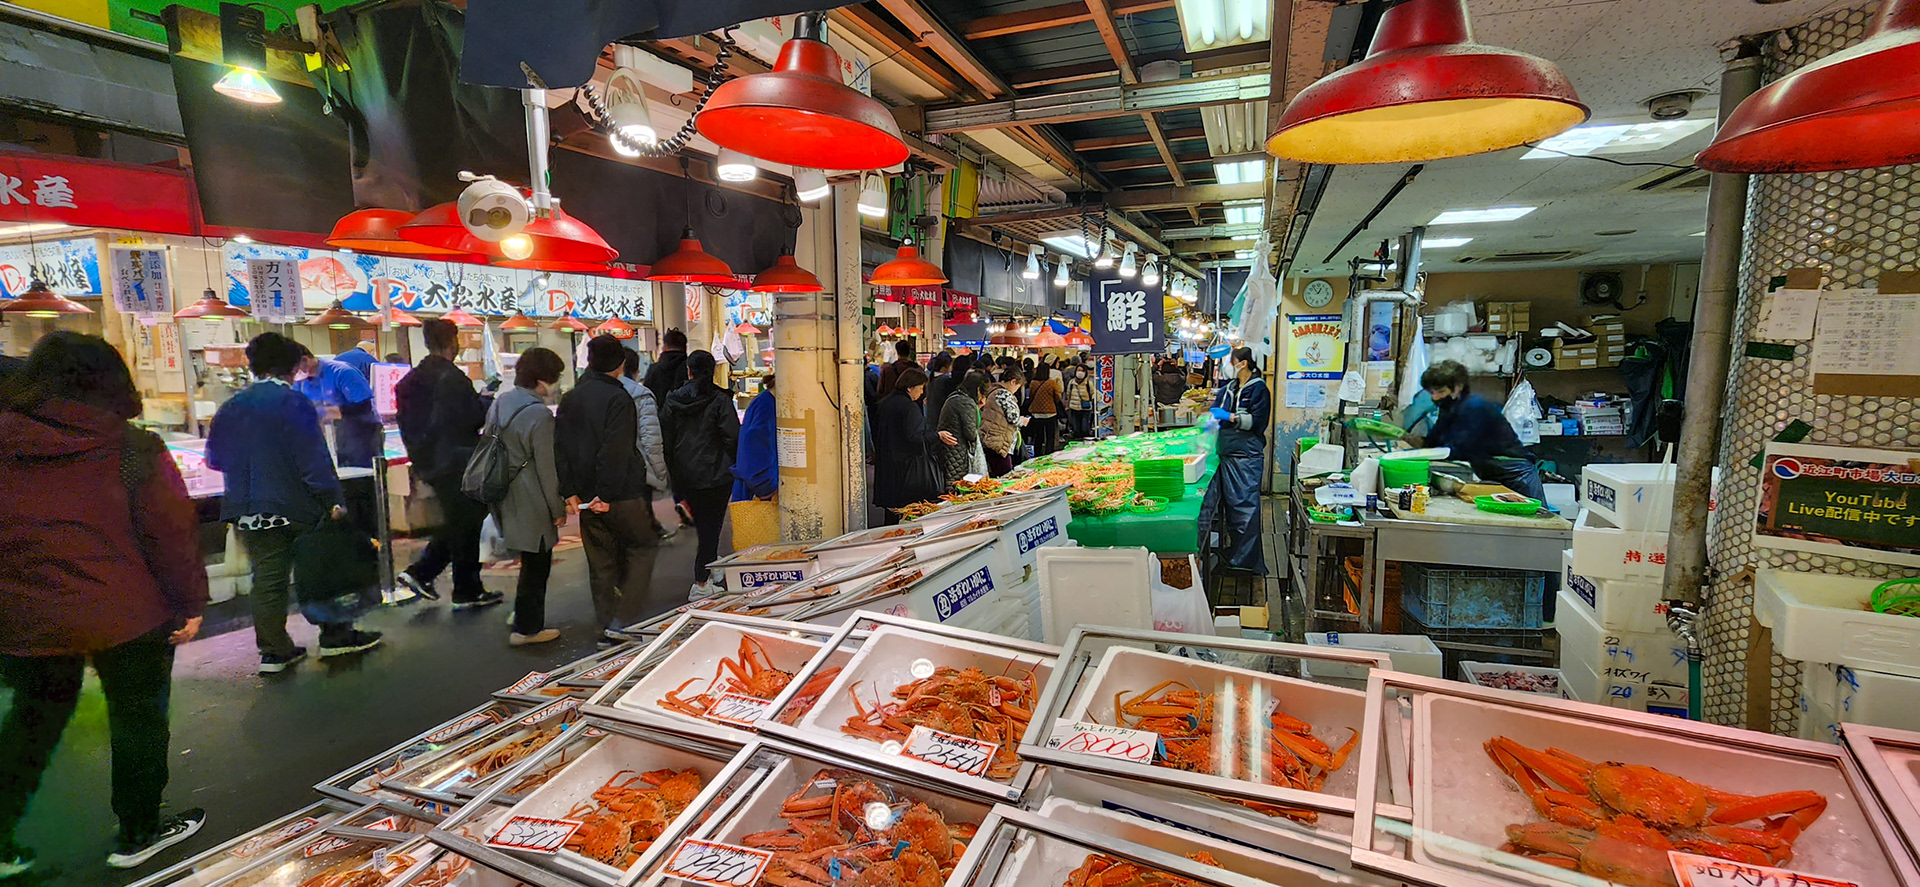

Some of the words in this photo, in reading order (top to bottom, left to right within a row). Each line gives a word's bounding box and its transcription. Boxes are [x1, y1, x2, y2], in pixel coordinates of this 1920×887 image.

[424, 280, 519, 313] 大松水産
[581, 293, 646, 318] 大松水産
[1802, 463, 1920, 484] 近江町市場大口
[1824, 490, 1908, 511] YouTube
